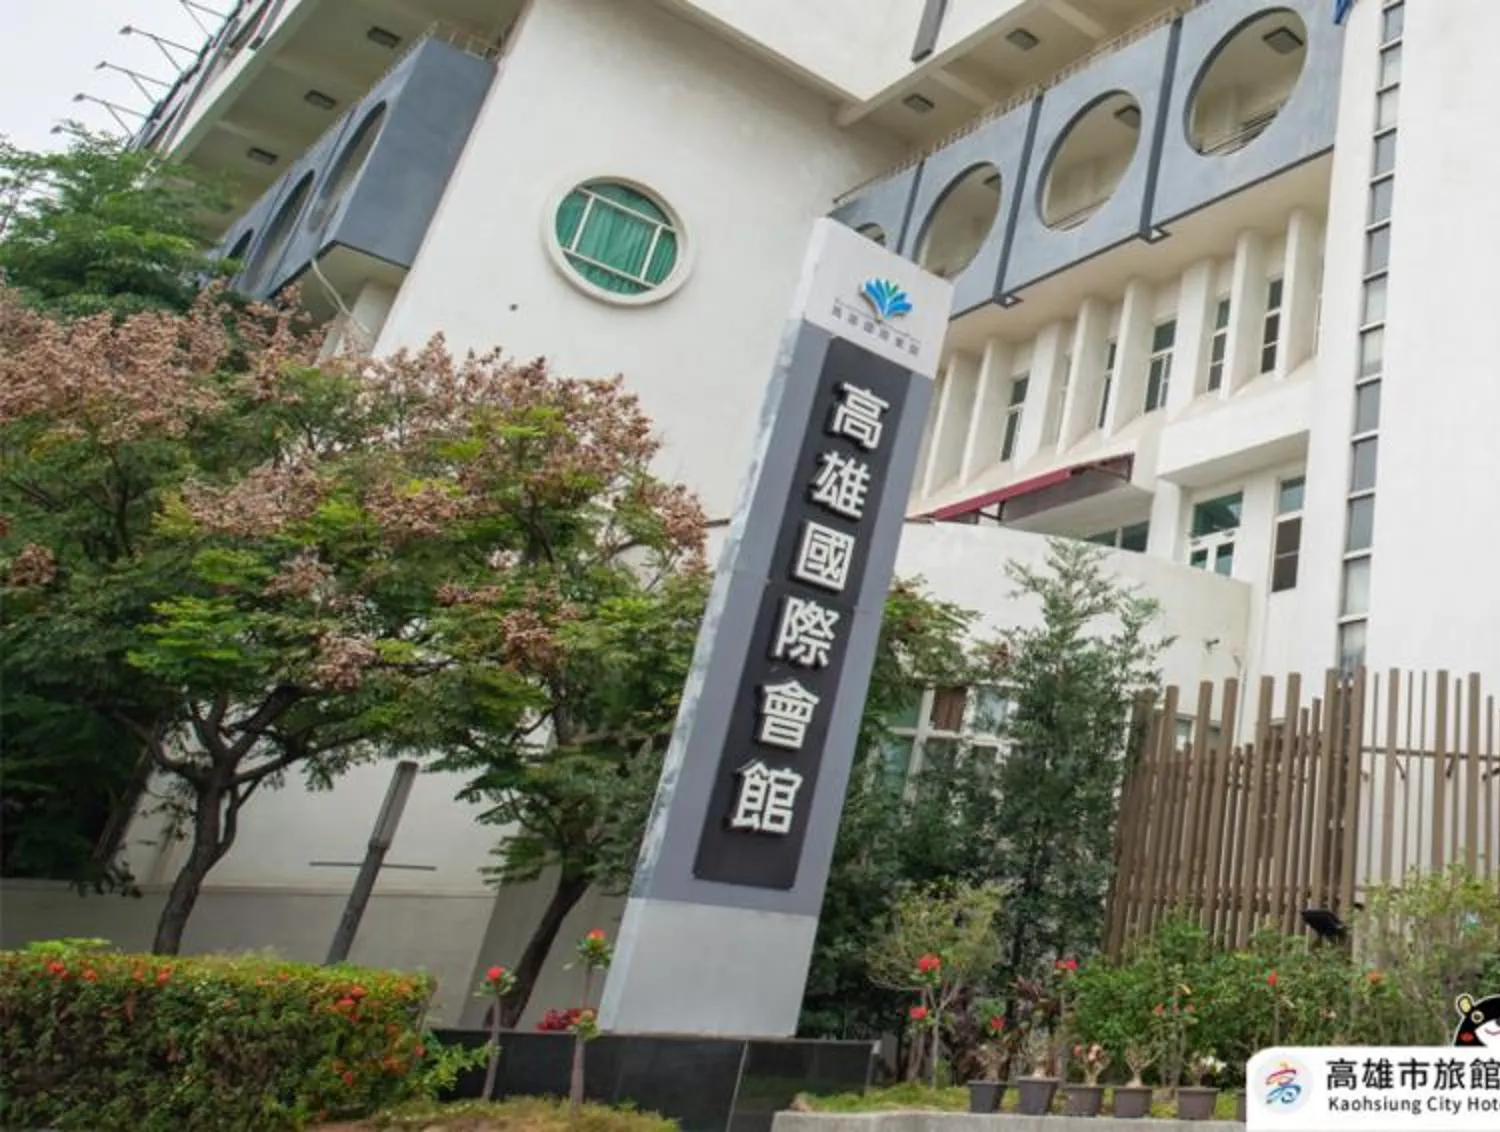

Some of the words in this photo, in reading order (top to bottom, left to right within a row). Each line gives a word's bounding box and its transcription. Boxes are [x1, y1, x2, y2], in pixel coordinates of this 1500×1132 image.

[731, 381, 890, 836] 高雄國際會館
